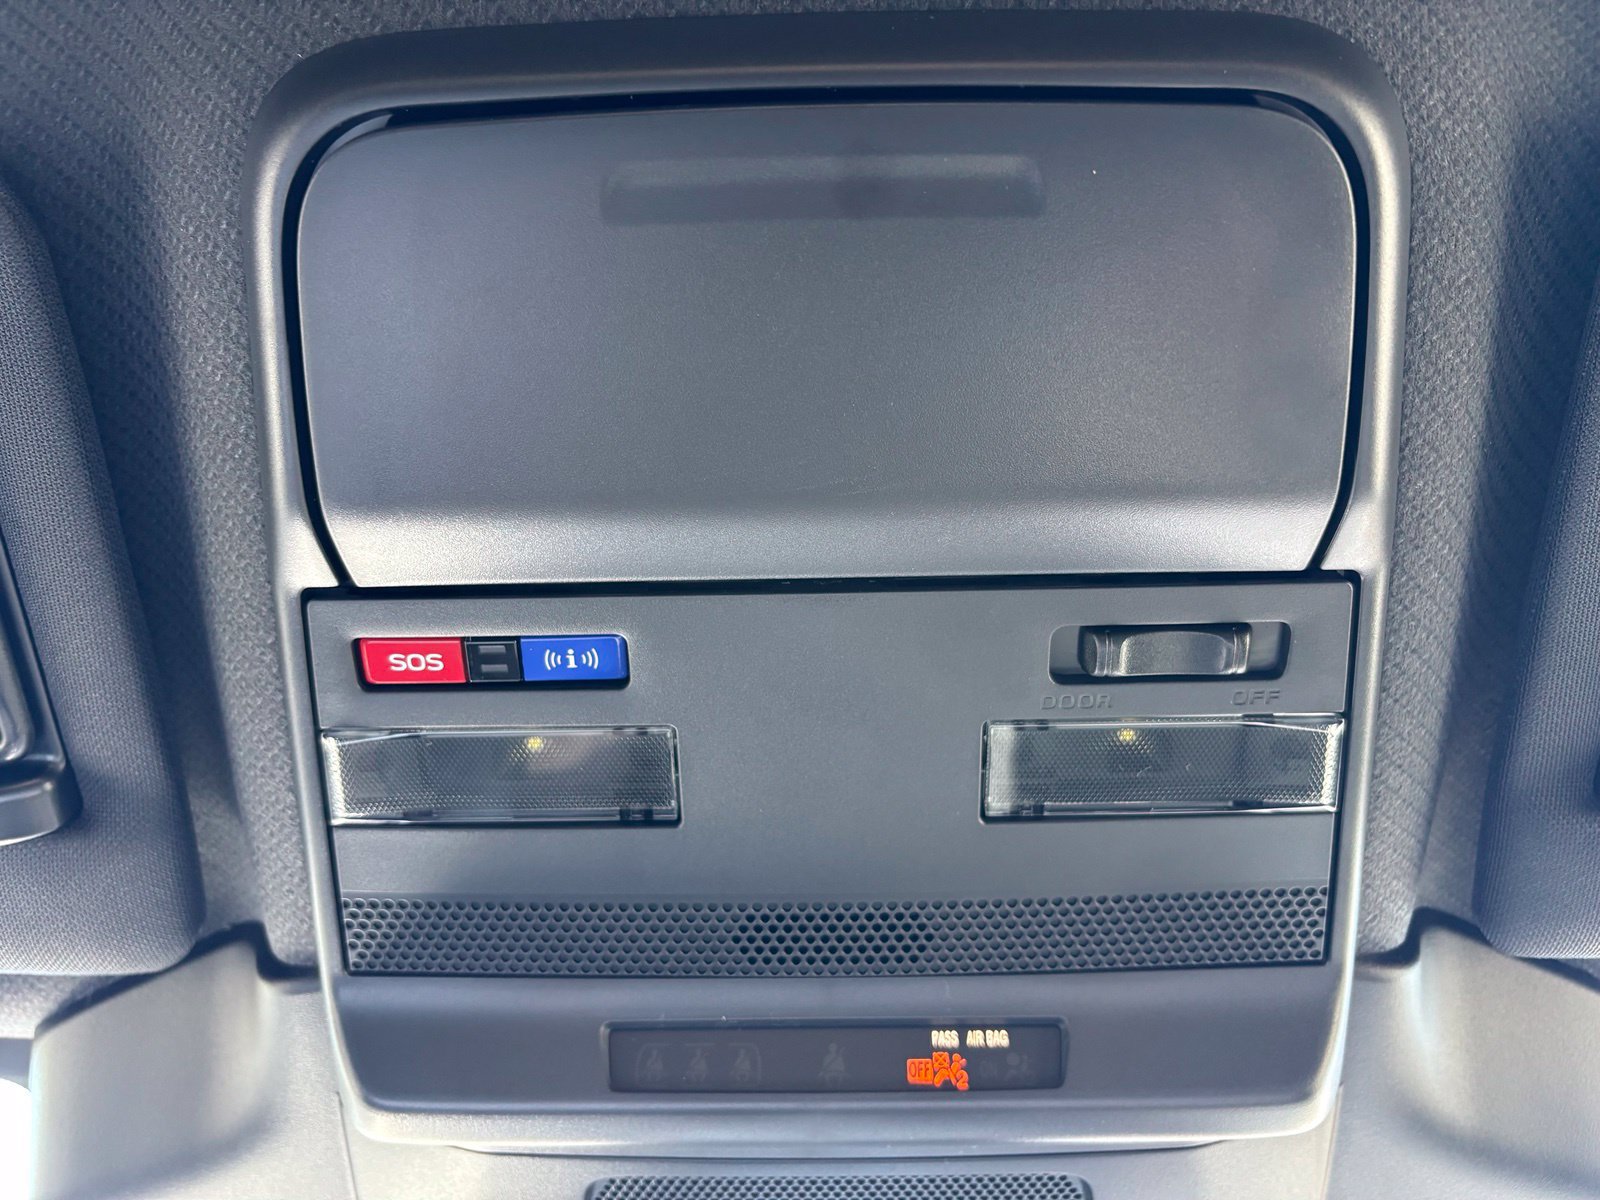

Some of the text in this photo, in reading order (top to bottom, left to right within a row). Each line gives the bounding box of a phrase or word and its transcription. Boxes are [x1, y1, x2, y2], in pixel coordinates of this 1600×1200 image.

[389, 653, 444, 671] SOS
[1040, 693, 1112, 710] DOOR
[1231, 690, 1281, 706] OFF
[931, 1029, 1010, 1048] PASS AIR BAG
[908, 1061, 930, 1077] OFF
